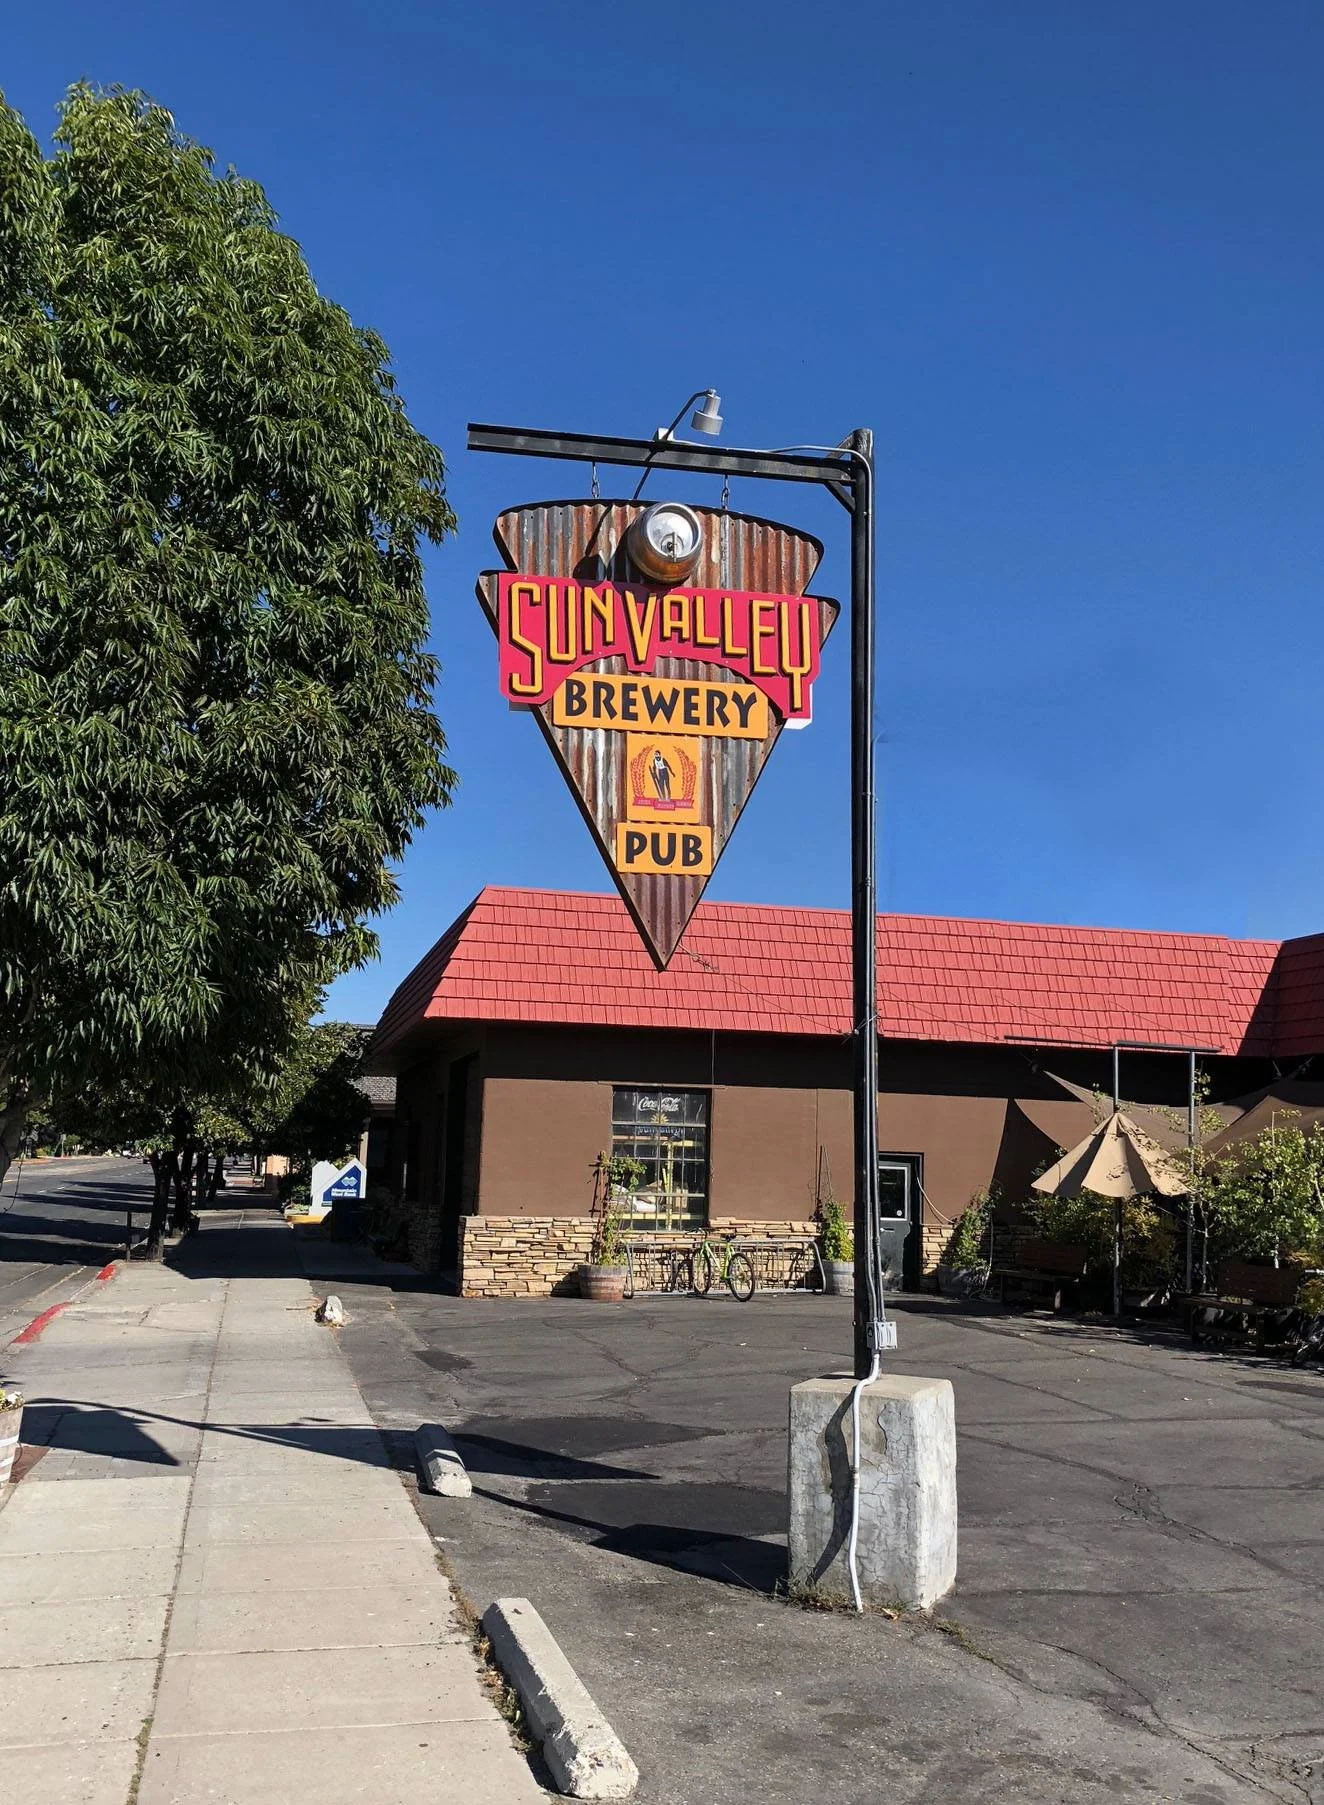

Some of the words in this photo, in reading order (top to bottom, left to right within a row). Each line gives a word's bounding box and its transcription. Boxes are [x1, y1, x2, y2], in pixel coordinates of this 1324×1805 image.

[510, 581, 615, 695] SUN
[625, 591, 811, 710] VALLEY
[565, 679, 757, 729] BREWERY
[625, 831, 703, 868] PUB
[638, 1096, 681, 1112] CocaCola
